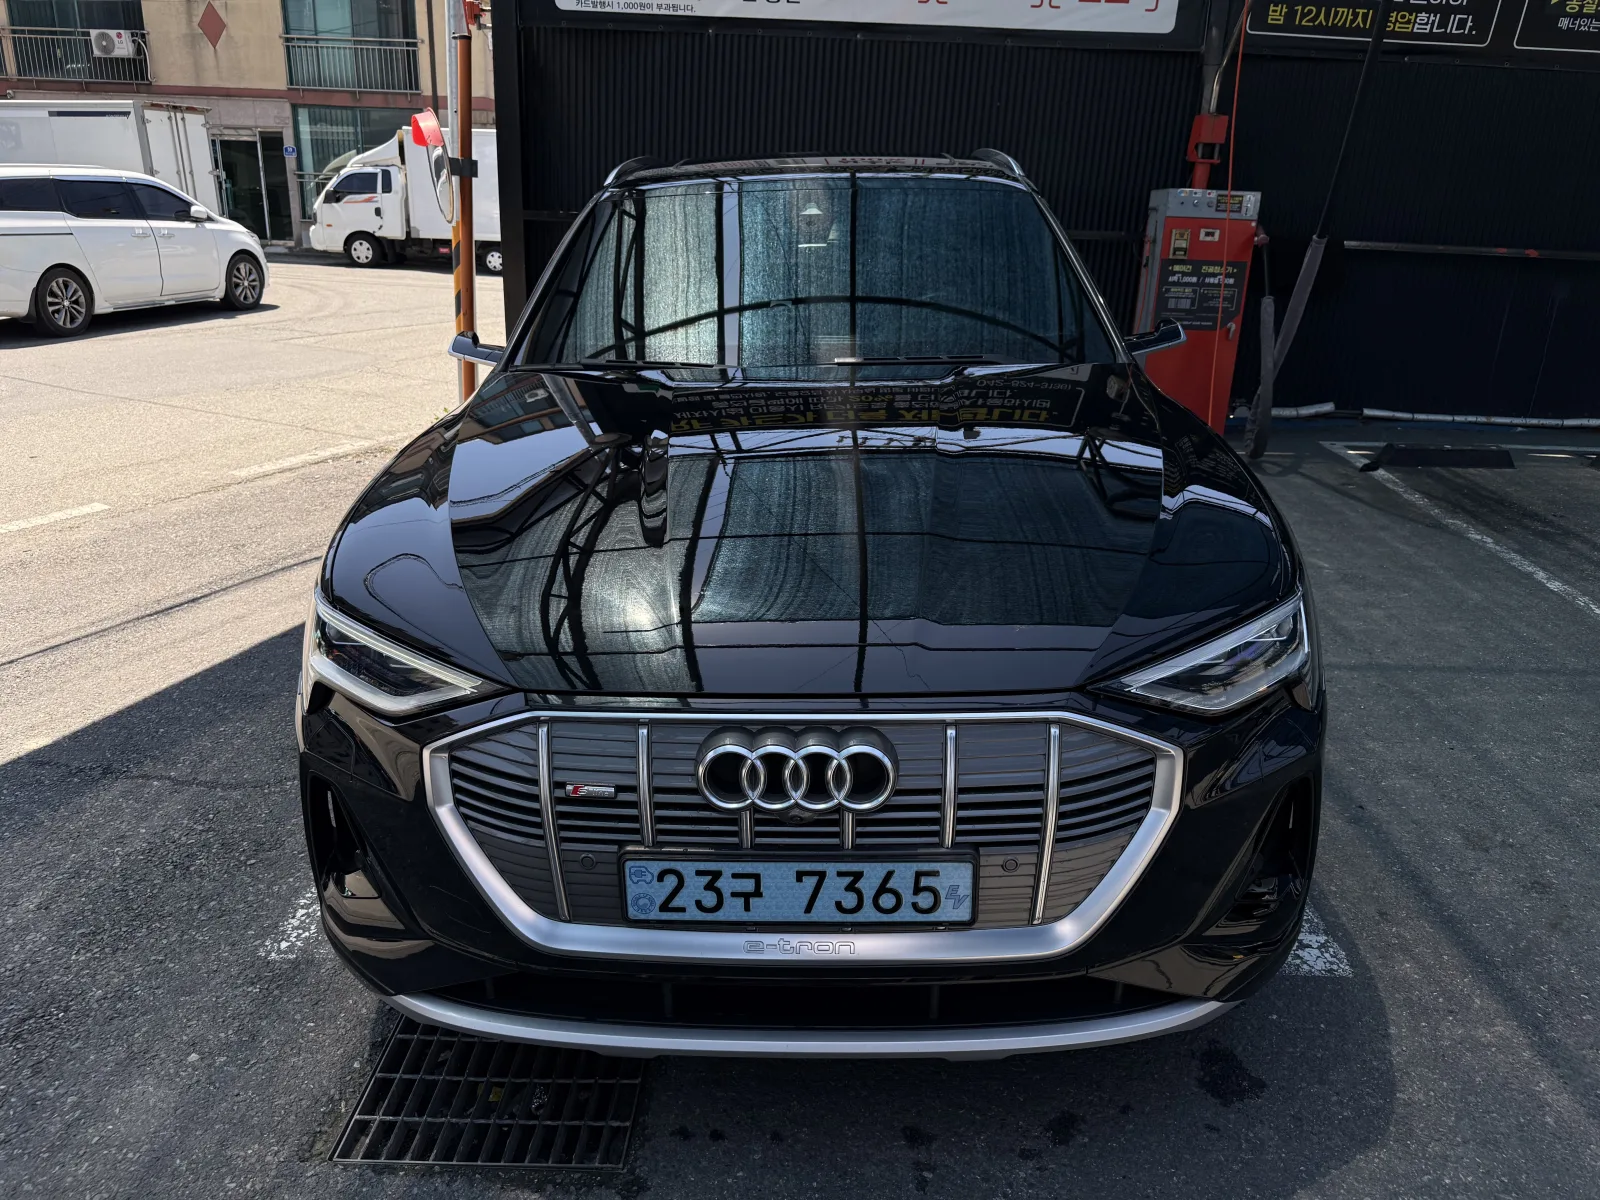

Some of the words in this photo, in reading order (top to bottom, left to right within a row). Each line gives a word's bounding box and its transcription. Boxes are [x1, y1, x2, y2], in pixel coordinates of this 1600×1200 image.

[575, 0, 614, 9] 카드발행시
[616, 1, 654, 12] 1,000원이
[656, 3, 696, 13] 부과됩니다.
[1267, 3, 1288, 24] 밤
[1294, 5, 1373, 29] 12시까지
[656, 868, 763, 913] 23구
[795, 869, 941, 915] 7365
[945, 884, 969, 910] EV
[742, 938, 856, 955] e-tron
